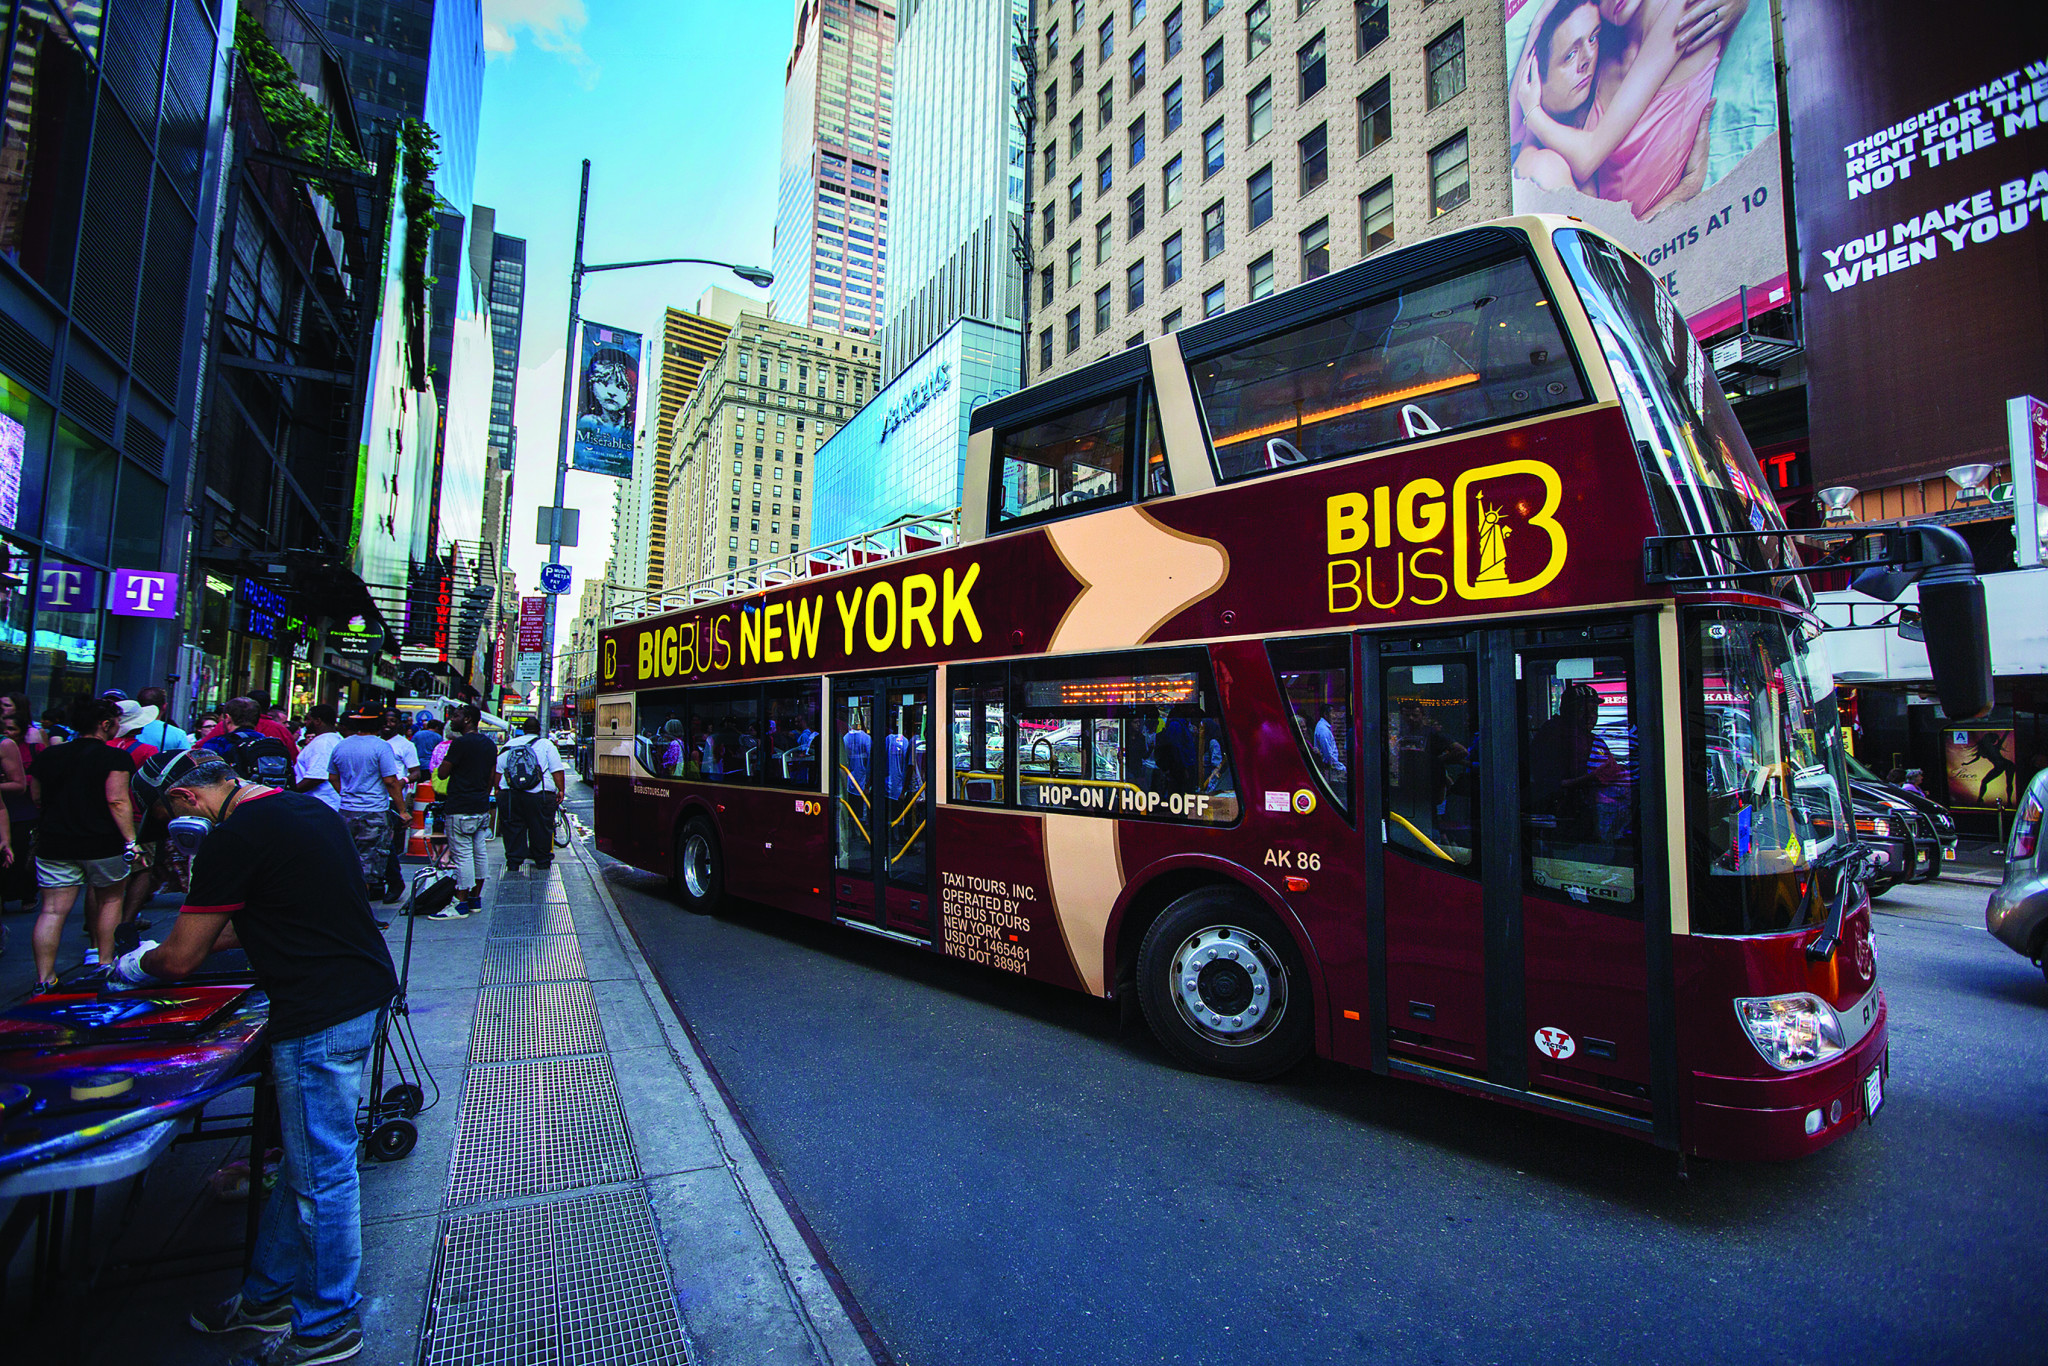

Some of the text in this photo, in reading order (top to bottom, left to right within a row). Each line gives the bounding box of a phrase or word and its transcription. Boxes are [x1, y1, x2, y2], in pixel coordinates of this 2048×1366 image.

[1844, 54, 2048, 160] THOUGHT THAT W
[1846, 132, 1919, 178] RENT
[1923, 107, 1982, 146] FOR
[1848, 154, 1917, 200] NOT
[1921, 121, 1997, 168] THE
[1706, 205, 1732, 236] AT
[1742, 186, 1768, 213] 10
[1822, 229, 1887, 268] YOU
[1892, 189, 1994, 245] MAKE
[1823, 235, 1937, 292] WHEN
[1326, 478, 1446, 555] BIG
[546, 567, 554, 576] P
[1328, 548, 1448, 614] BUS
[638, 614, 731, 680] BIGBUS
[740, 594, 823, 666] NEW
[836, 562, 982, 656] YORK
[1039, 785, 1104, 808] HOP-ON
[1121, 790, 1210, 816] HOP-OFF
[1264, 848, 1321, 872] AK 86
[942, 872, 1037, 902] TAXI TOURS, INC.
[942, 888, 1020, 915] OPERATED BY
[943, 901, 1030, 932] BIG BUS TOURS
[944, 915, 1002, 940] NEW YORK
[944, 928, 1030, 962] USDOT 1465461
[945, 941, 1027, 975] NYS DOT 38991
[1542, 1040, 1568, 1051] VECTOR
